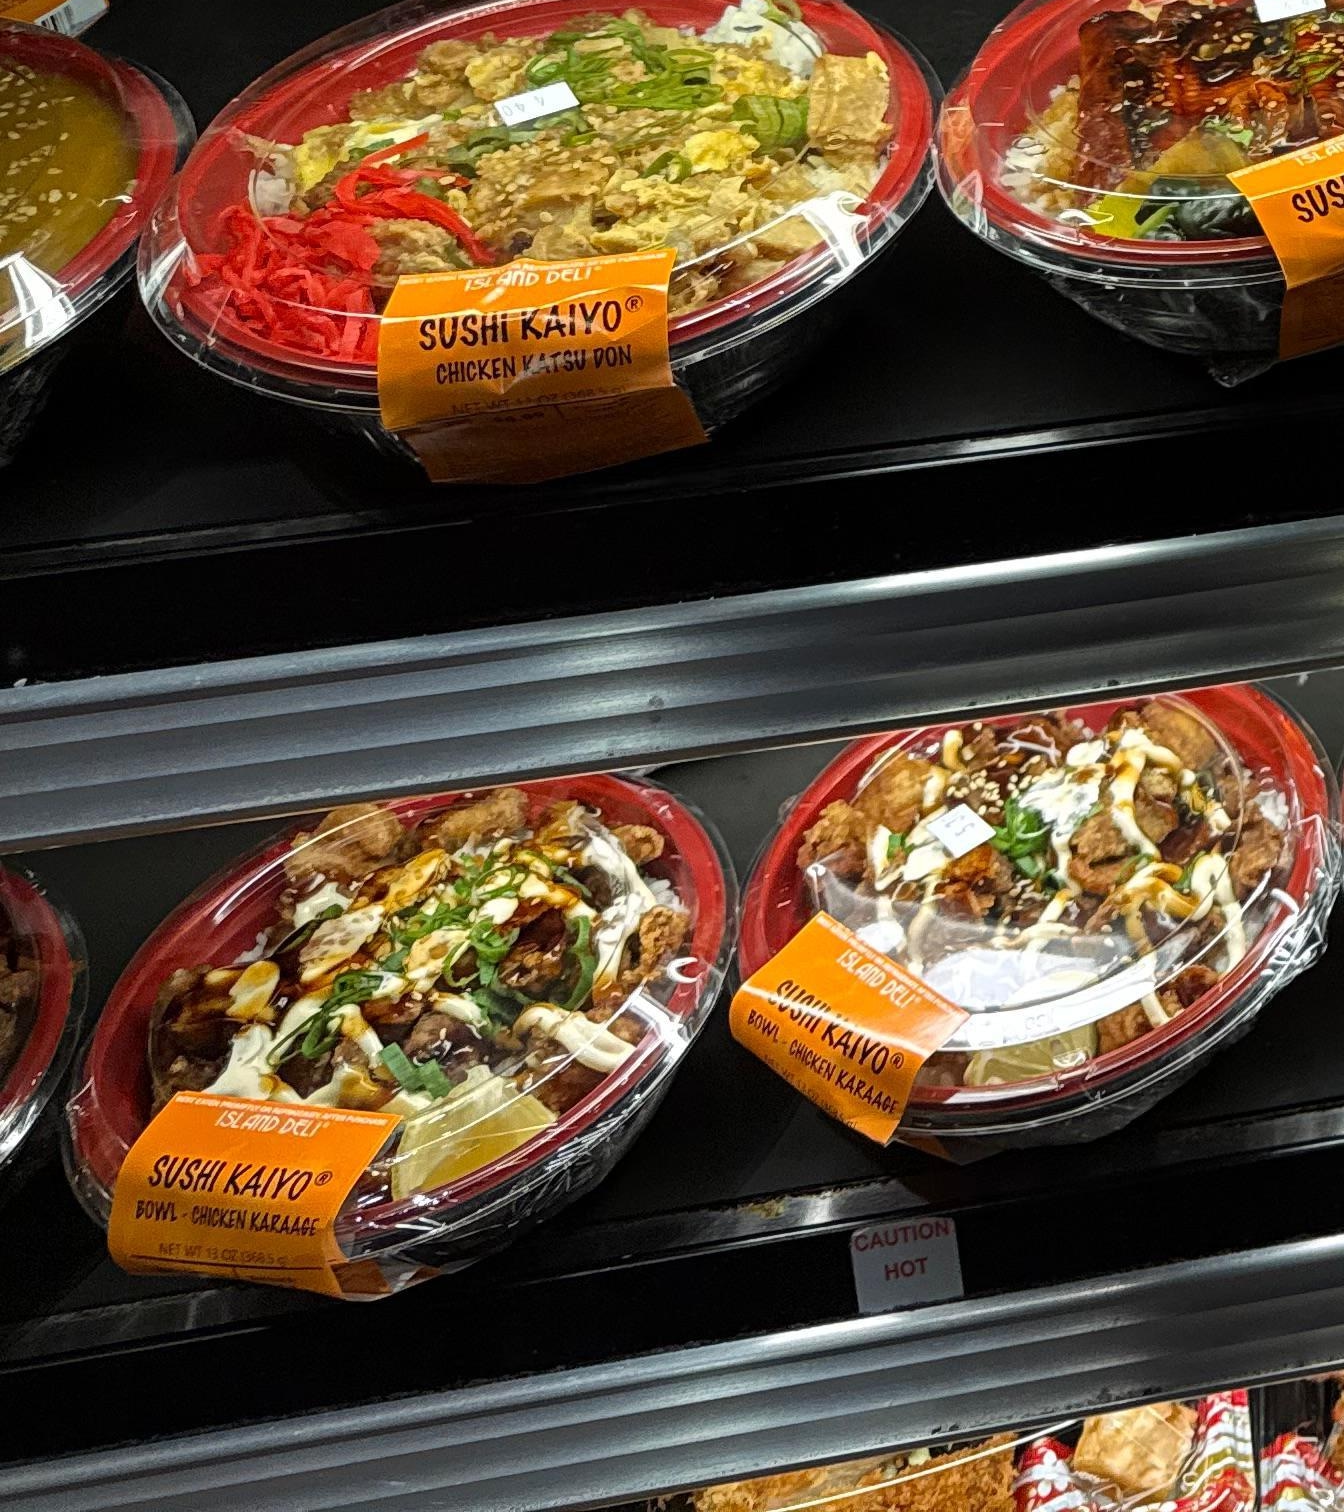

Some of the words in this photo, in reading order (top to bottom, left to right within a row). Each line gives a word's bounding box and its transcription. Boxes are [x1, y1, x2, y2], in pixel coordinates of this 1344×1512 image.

[419, 313, 509, 352] SUSHI
[435, 356, 516, 386] CHICKEN
[522, 349, 587, 378] KATSU
[593, 343, 633, 369] DON
[747, 1008, 781, 1043] BOWL
[788, 1038, 836, 1081] CHICKEN
[835, 1069, 900, 1115] KARAAGE
[147, 1153, 226, 1194] SUSHI
[135, 1199, 178, 1223] BOWL
[190, 1205, 247, 1231] CHICKEN
[249, 1211, 321, 1239] KARAAGE
[853, 1219, 950, 1253] CAUTION
[883, 1256, 929, 1282] HOT
